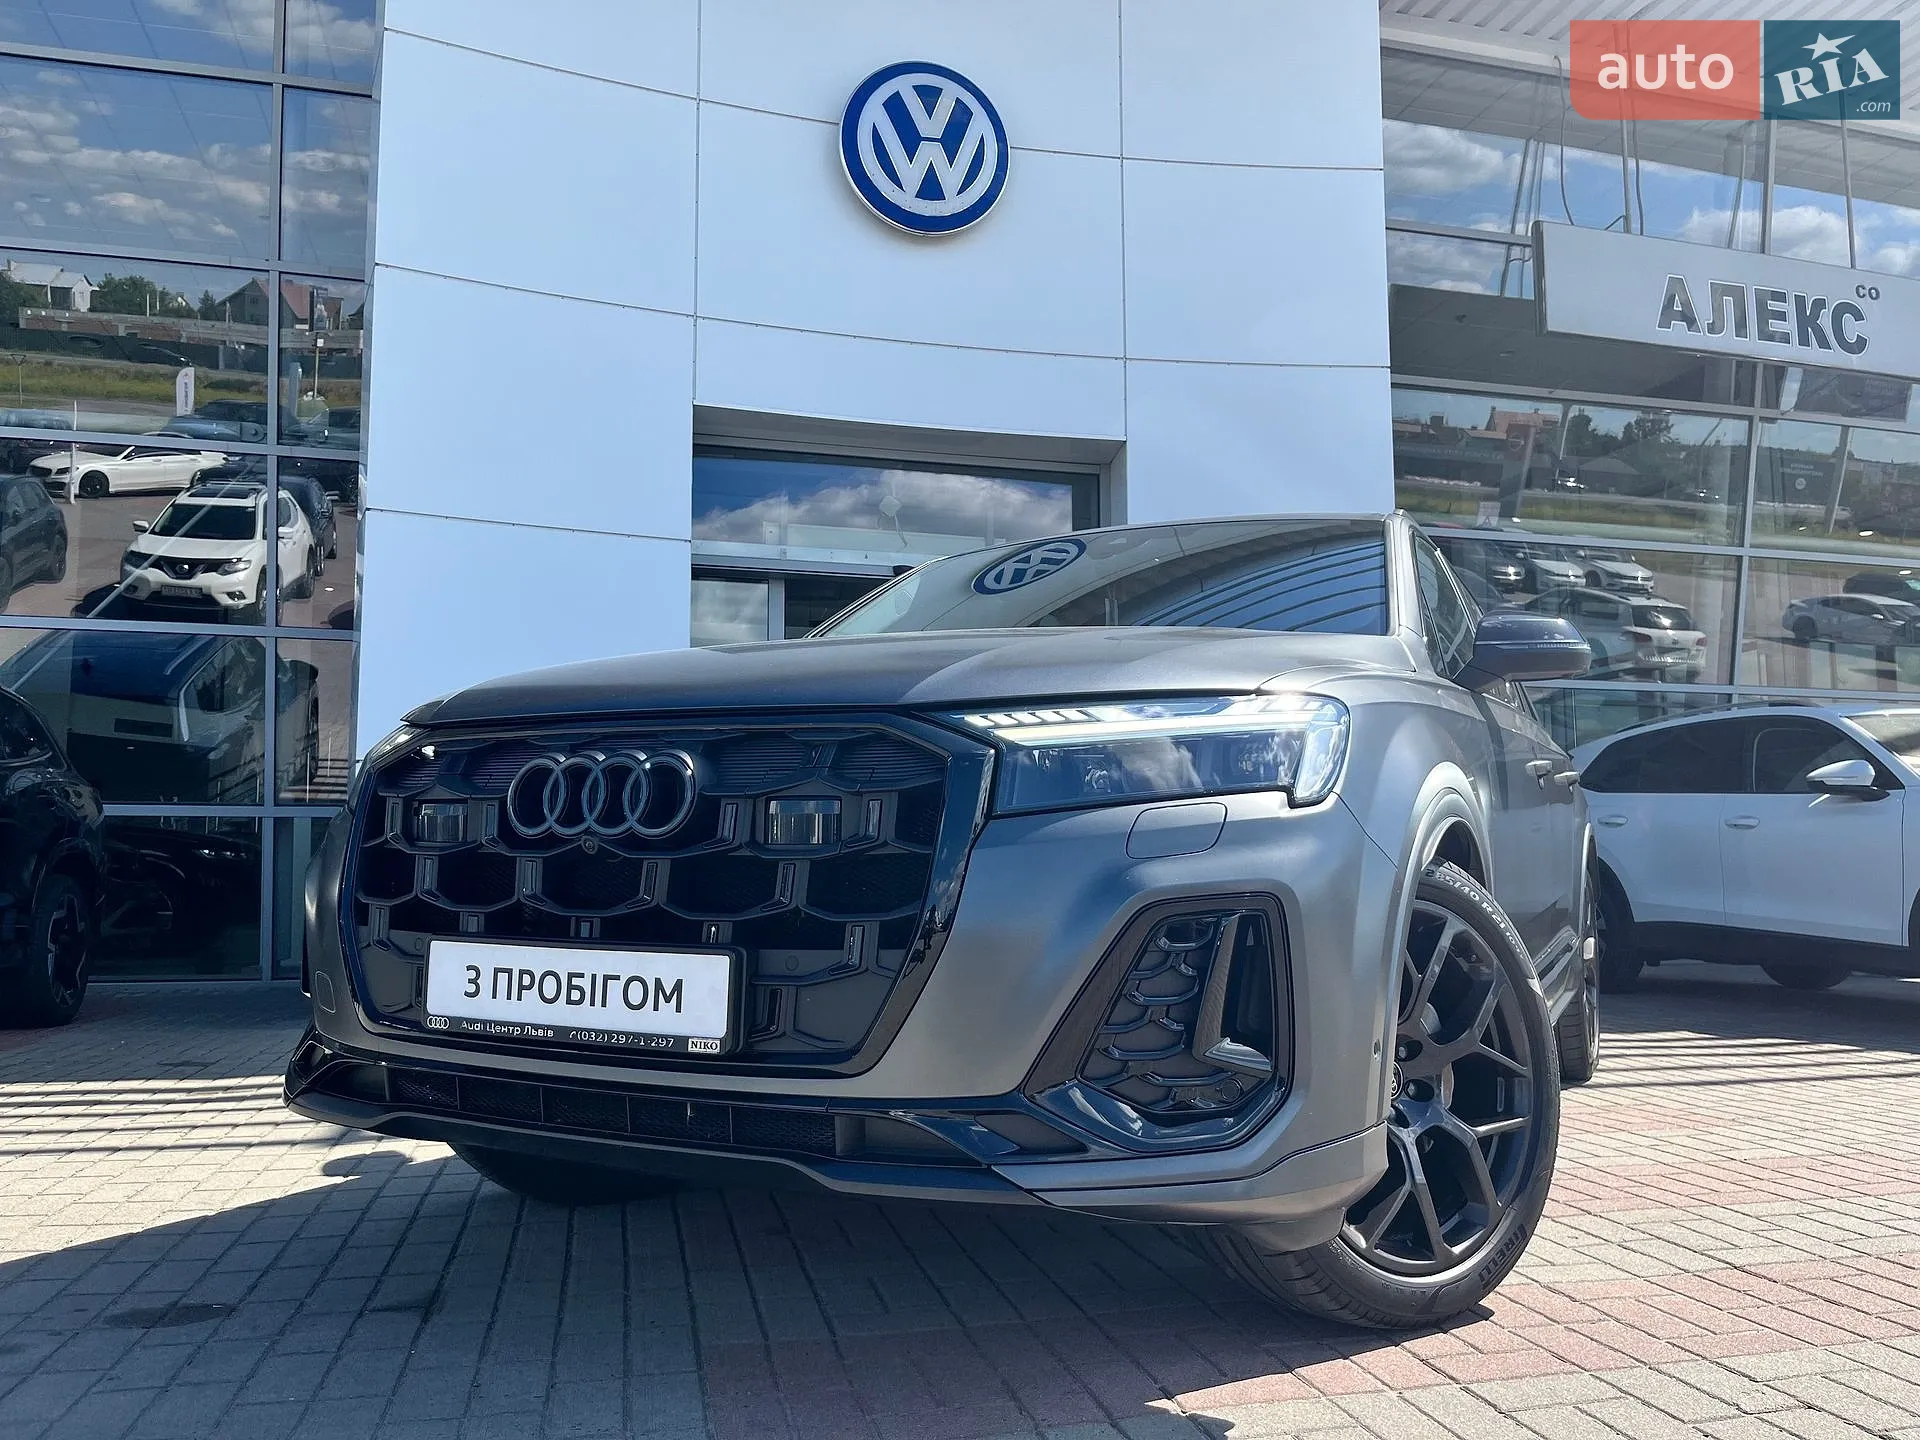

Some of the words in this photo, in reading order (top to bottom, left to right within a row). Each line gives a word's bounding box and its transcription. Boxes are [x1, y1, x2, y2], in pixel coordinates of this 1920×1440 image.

[857, 71, 998, 217] VW
[1655, 274, 1870, 356] АЛЕКС
[491, 967, 684, 1014] ПРОБІГОМ
[460, 1020, 484, 1031] Audi
[486, 1022, 521, 1036] Центр
[523, 1025, 554, 1037] Львів
[577, 1030, 608, 1043] (032)
[689, 1040, 719, 1052] NIKO
[1478, 1223, 1527, 1288] PIRELLI
